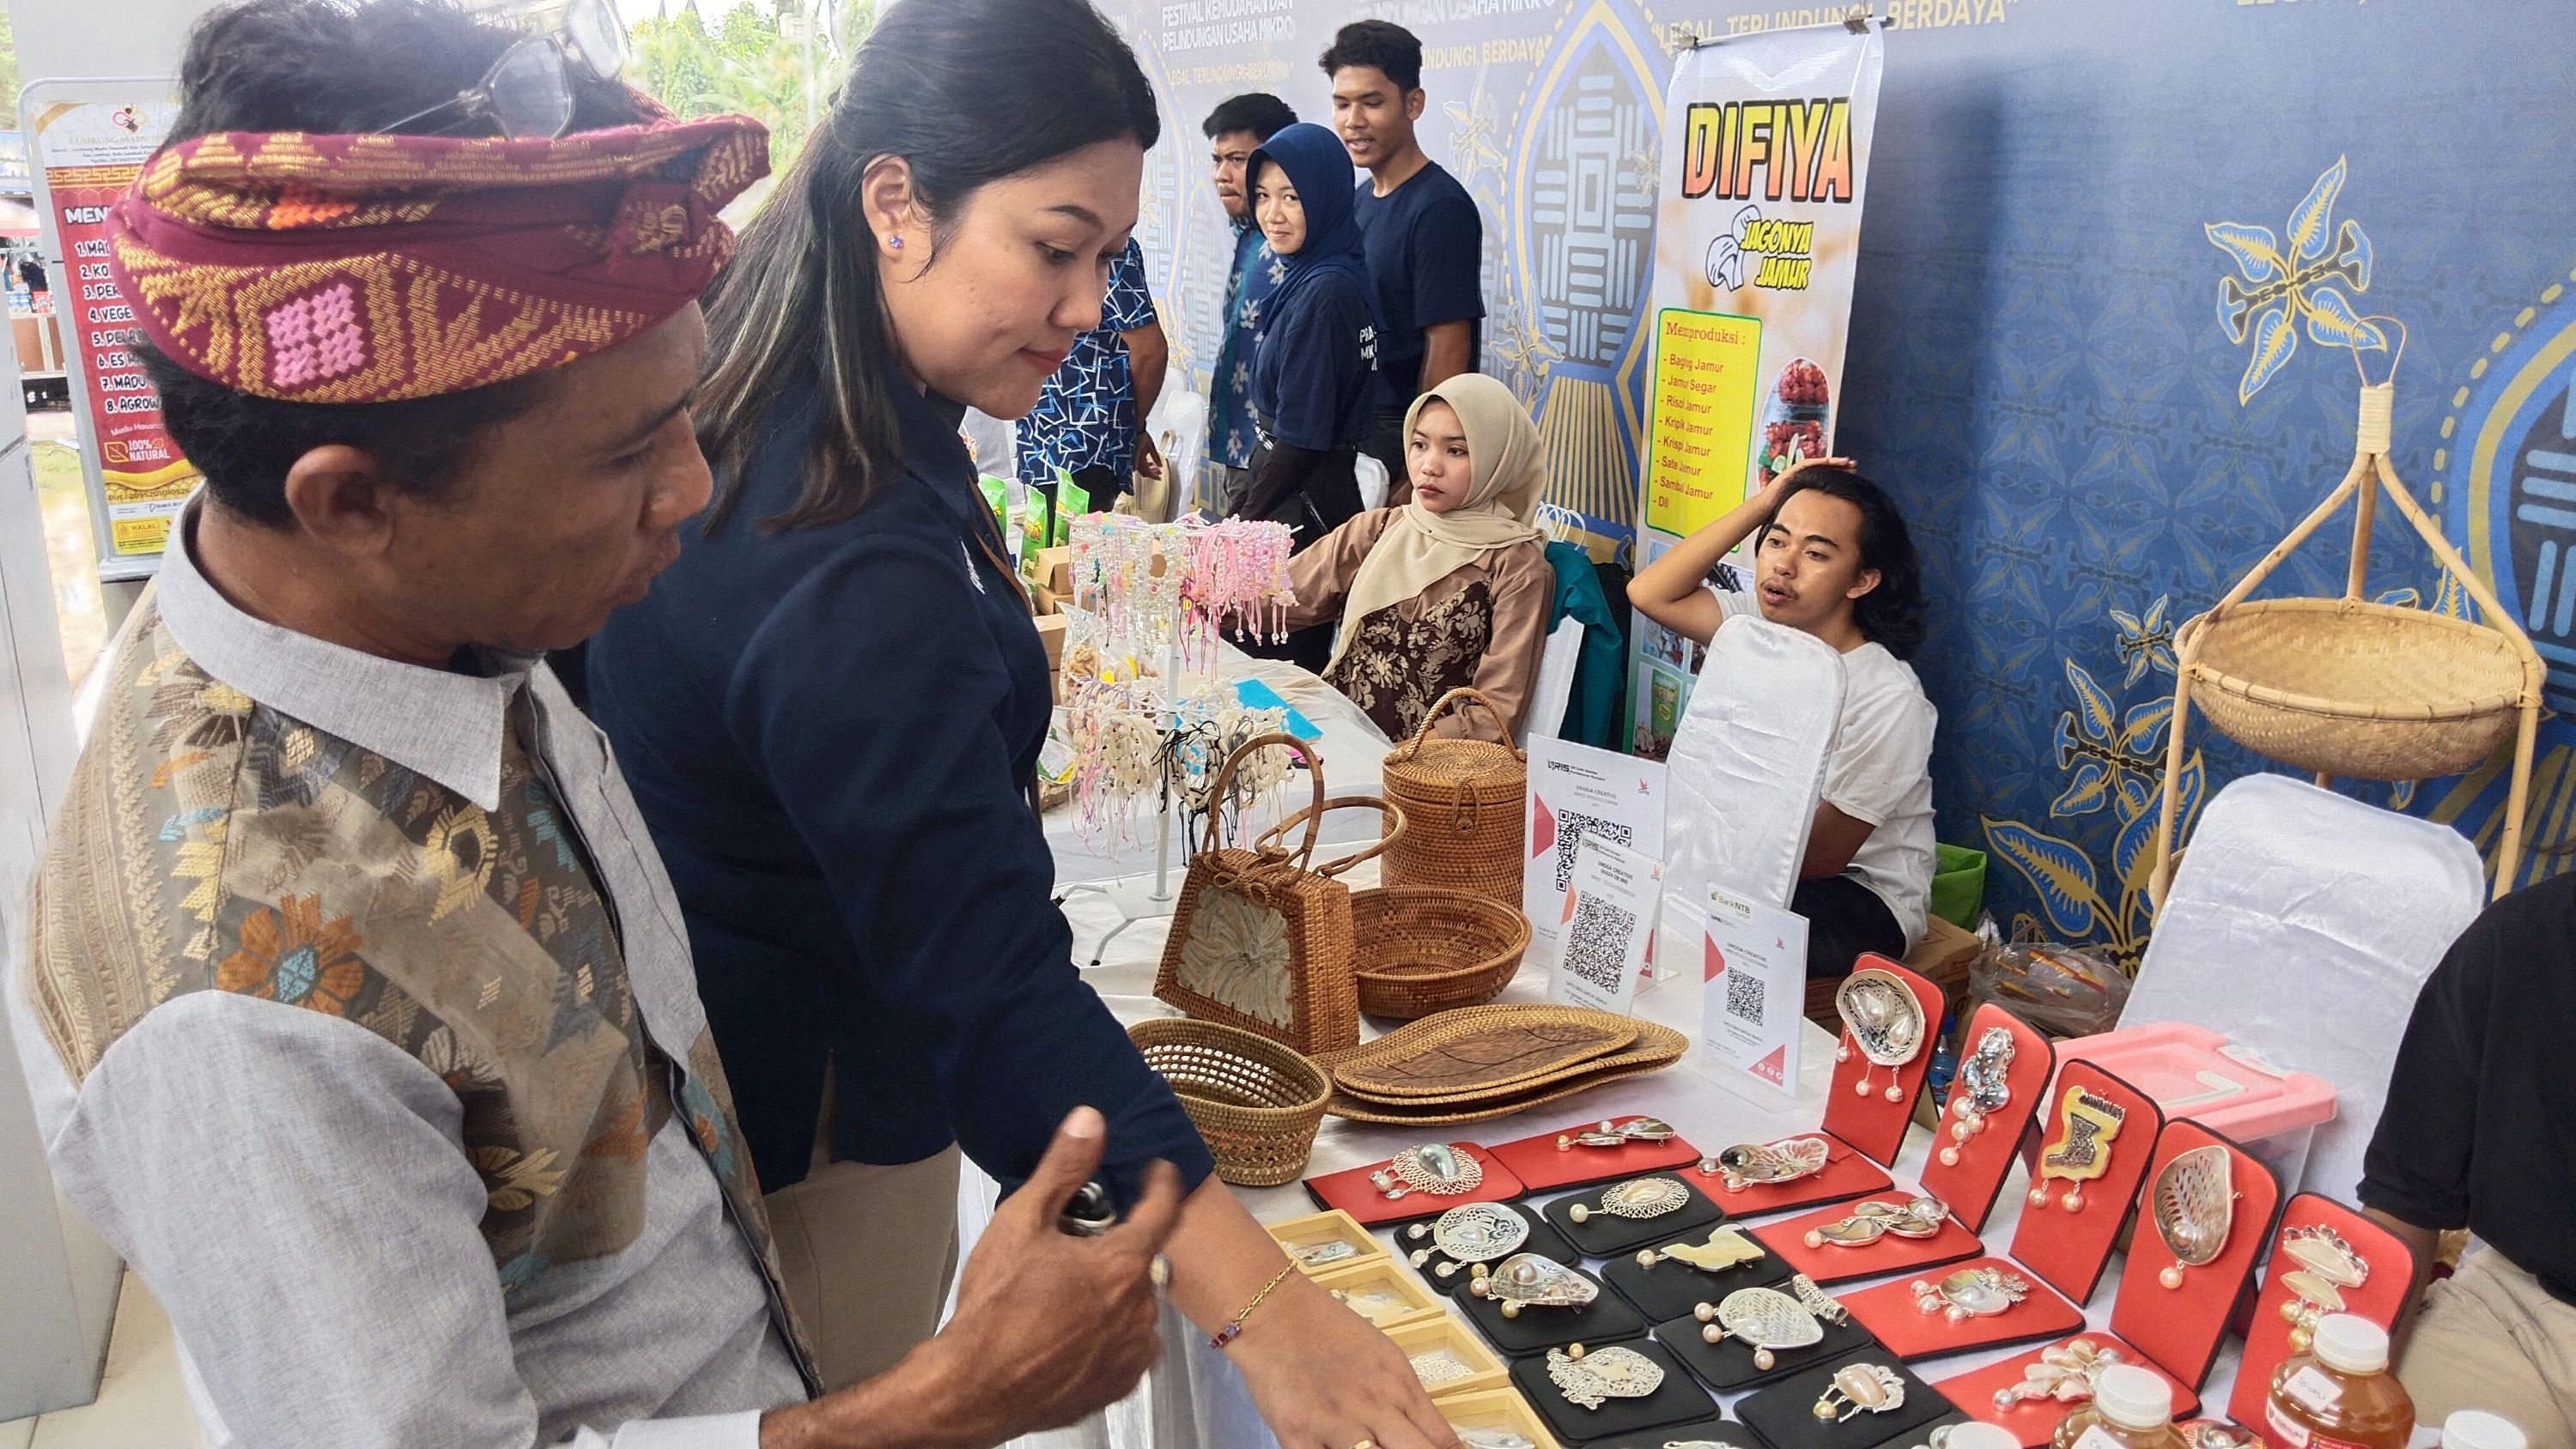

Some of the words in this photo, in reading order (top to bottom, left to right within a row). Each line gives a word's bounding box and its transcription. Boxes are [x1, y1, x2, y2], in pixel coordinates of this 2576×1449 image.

[1162, 2, 1203, 27] FESTIVAL
[1163, 24, 1223, 52] PELINDUNGAN
[1224, 20, 1258, 45] USAHA
[1681, 96, 1853, 203] DIFIYA
[1739, 219, 1814, 254] JAGONYA
[81, 266, 91, 277] 2.
[1754, 256, 1812, 290] JAMUR
[84, 287, 94, 298] 3.
[89, 310, 100, 321] 4.
[93, 334, 104, 345] 5.
[98, 355, 108, 367] 6.
[111, 354, 125, 367] ES
[1694, 359, 1724, 373] Jamur
[101, 379, 112, 390] 7.
[1668, 374, 1689, 389] Jamur
[1690, 379, 1717, 395] Segar
[106, 400, 118, 412] 8.
[1686, 399, 1712, 414] Jamur
[110, 426, 133, 436] Madu
[1665, 415, 1685, 431] Kripik
[1686, 421, 1714, 436] Jamur
[128, 439, 152, 451] 100%
[1662, 435, 1684, 452] Krispi
[1685, 441, 1711, 458] Jamur
[129, 449, 171, 462] NATURAL
[1661, 455, 1678, 470] Sate
[1679, 461, 1702, 476] Jamur
[1659, 476, 1684, 493] Sambal
[1685, 483, 1714, 500] Jamur
